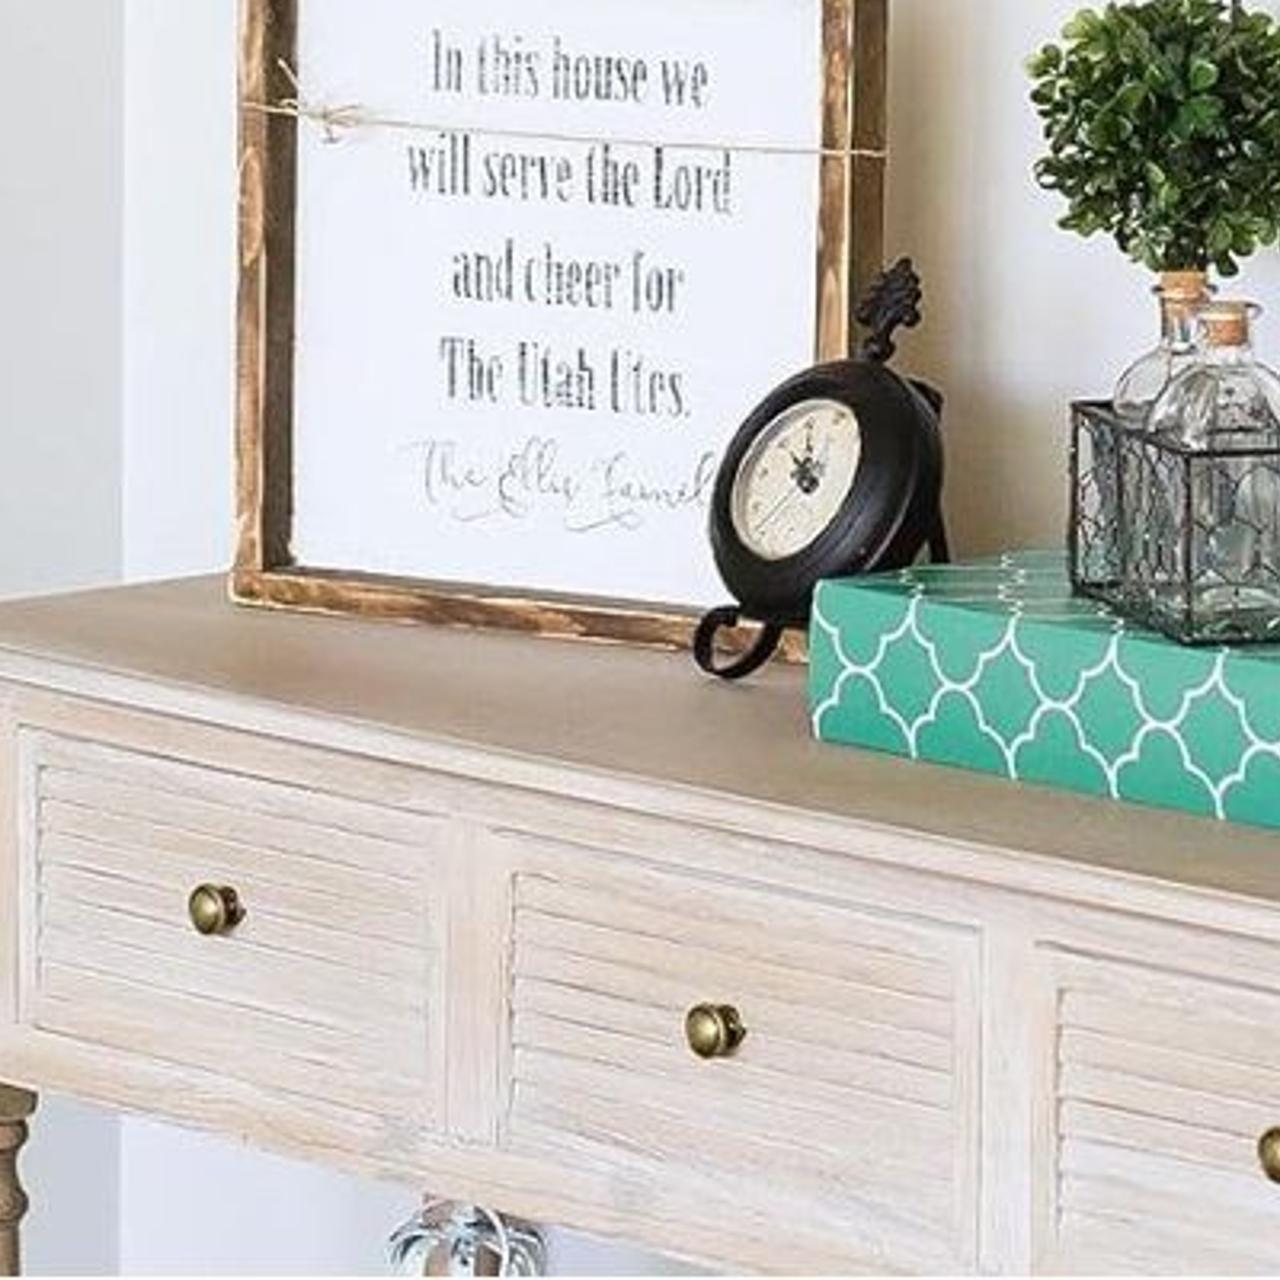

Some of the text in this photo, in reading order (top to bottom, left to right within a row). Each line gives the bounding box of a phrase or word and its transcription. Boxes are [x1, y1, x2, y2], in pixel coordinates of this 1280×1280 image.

[432, 28, 709, 108] In this house we
[407, 132, 732, 215] will serve the Lord
[453, 237, 685, 313] and cheer for
[439, 335, 504, 403] The
[518, 340, 596, 410] Utah
